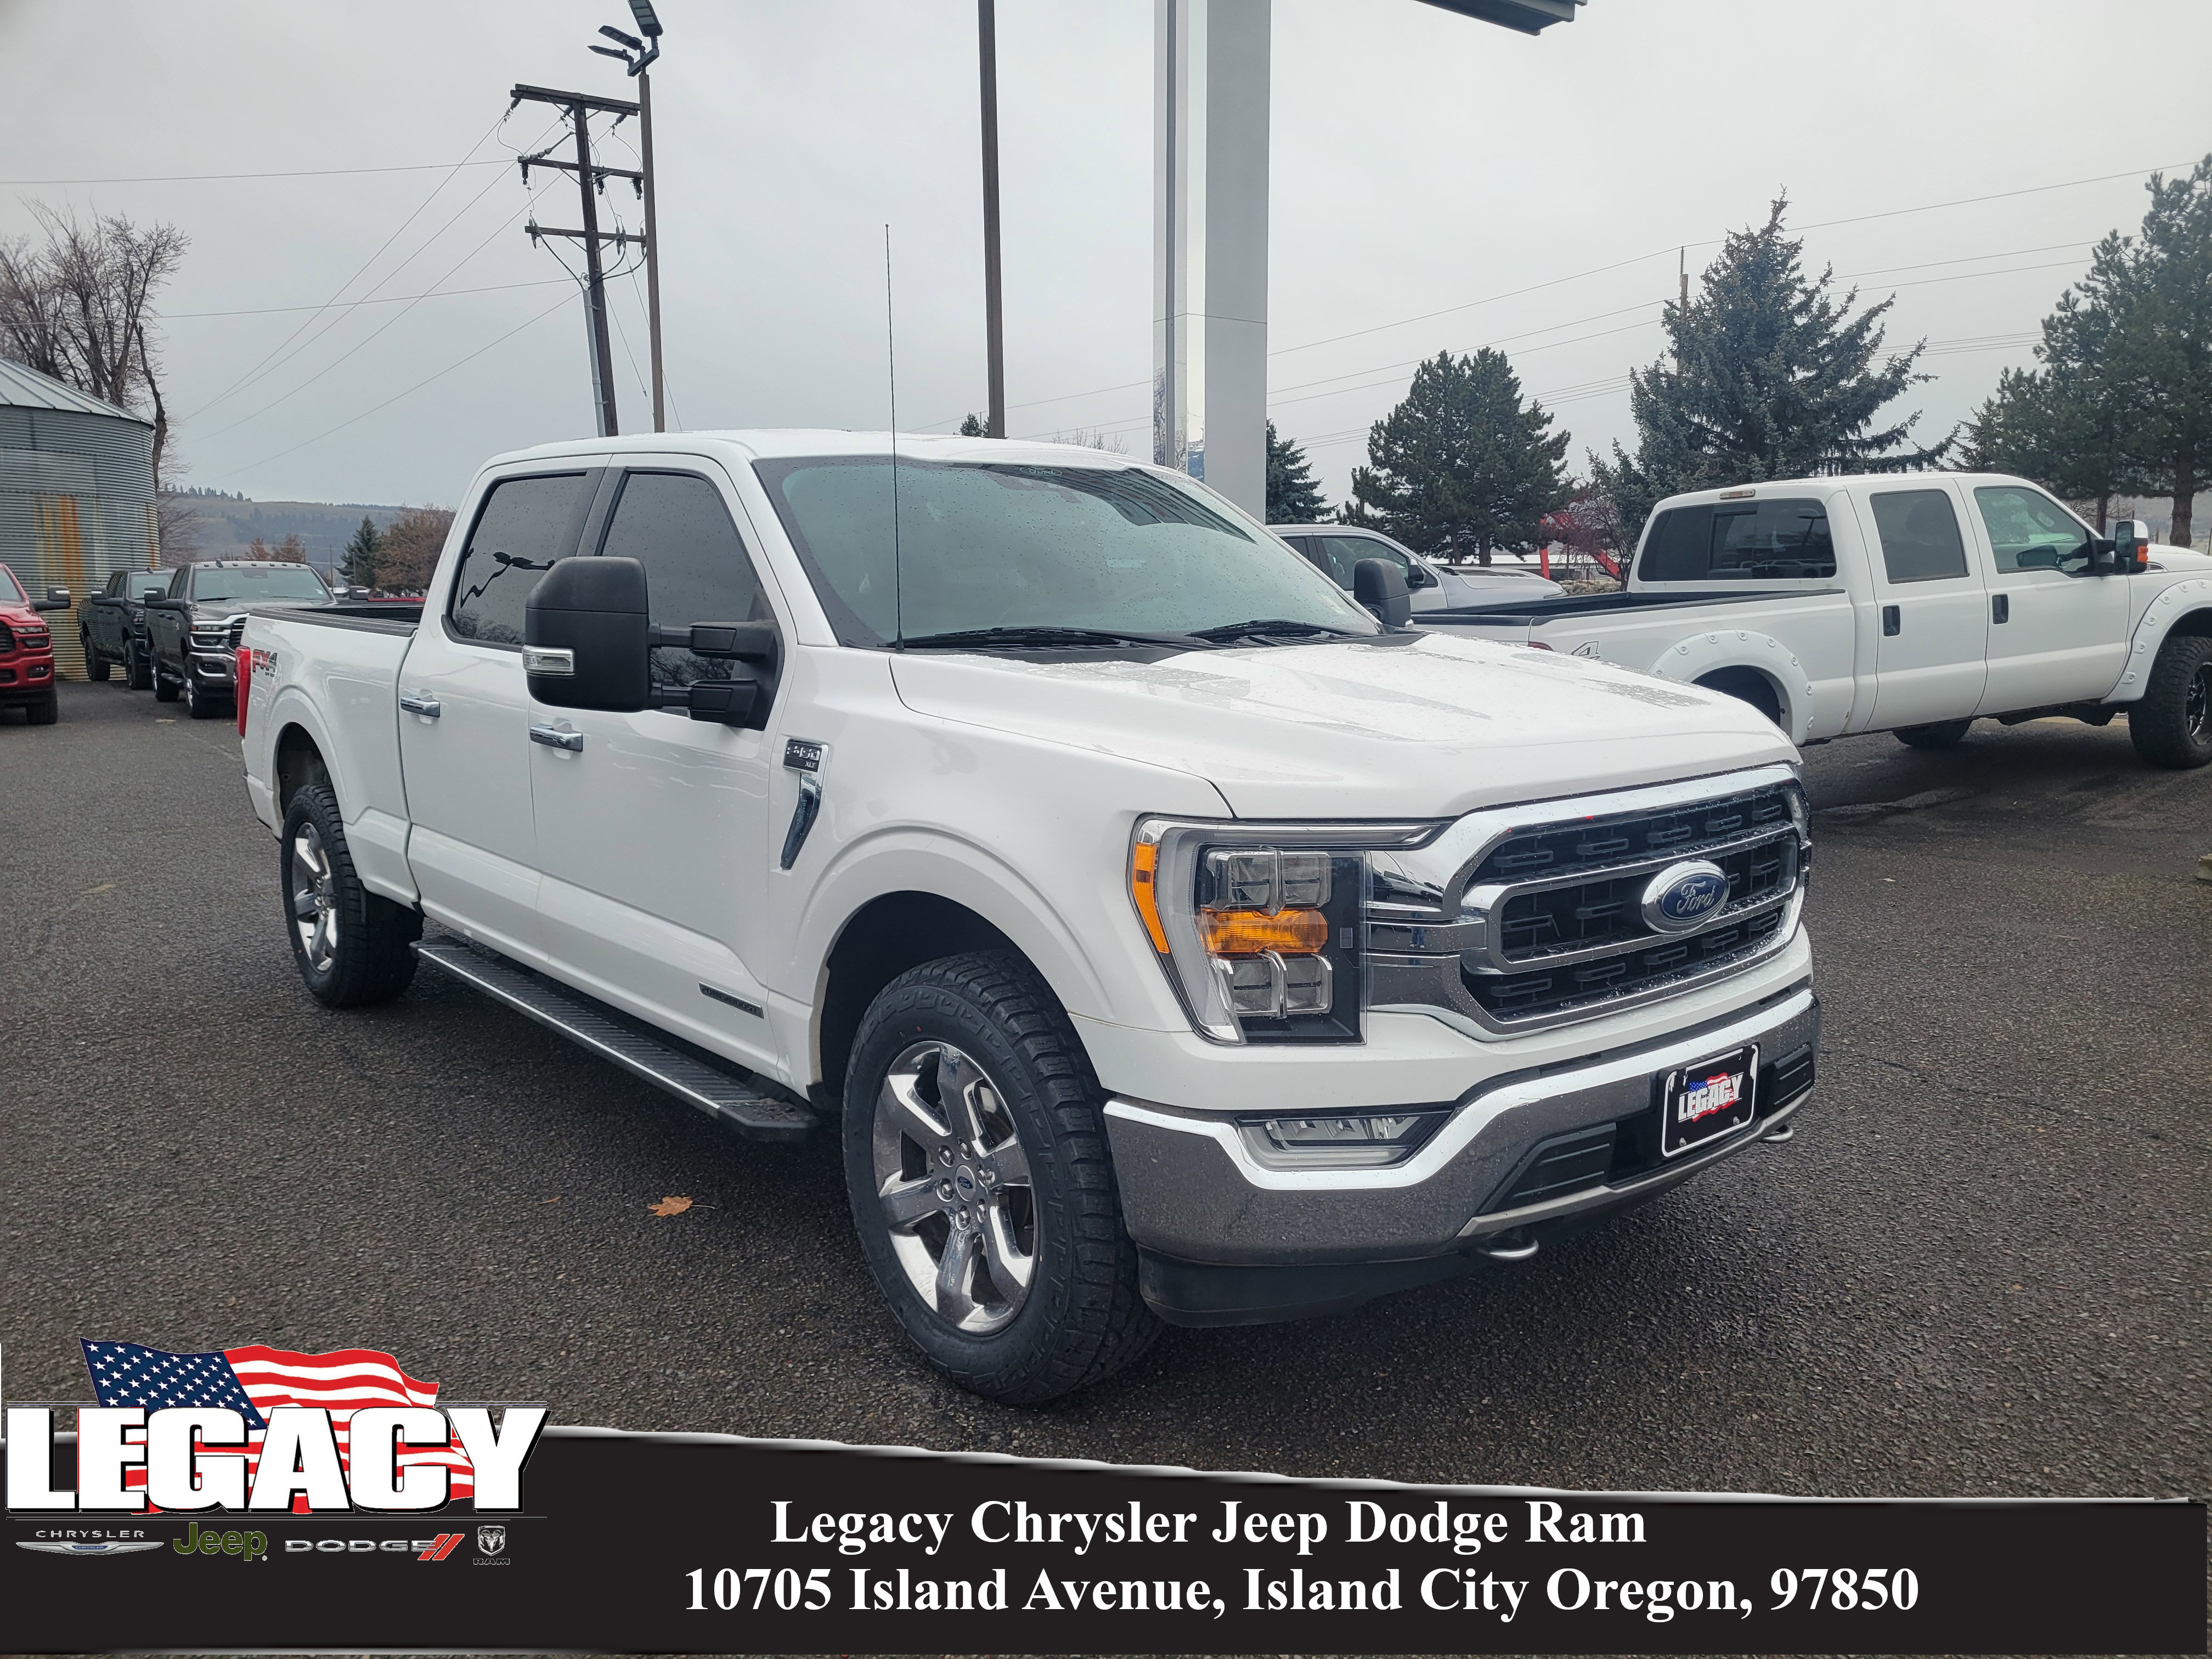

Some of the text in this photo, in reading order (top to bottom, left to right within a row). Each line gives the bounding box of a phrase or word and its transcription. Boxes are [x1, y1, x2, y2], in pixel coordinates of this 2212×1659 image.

[253, 648, 278, 673] FX4
[1677, 881, 1716, 914] Ford
[1678, 1074, 1744, 1122] LEGACY
